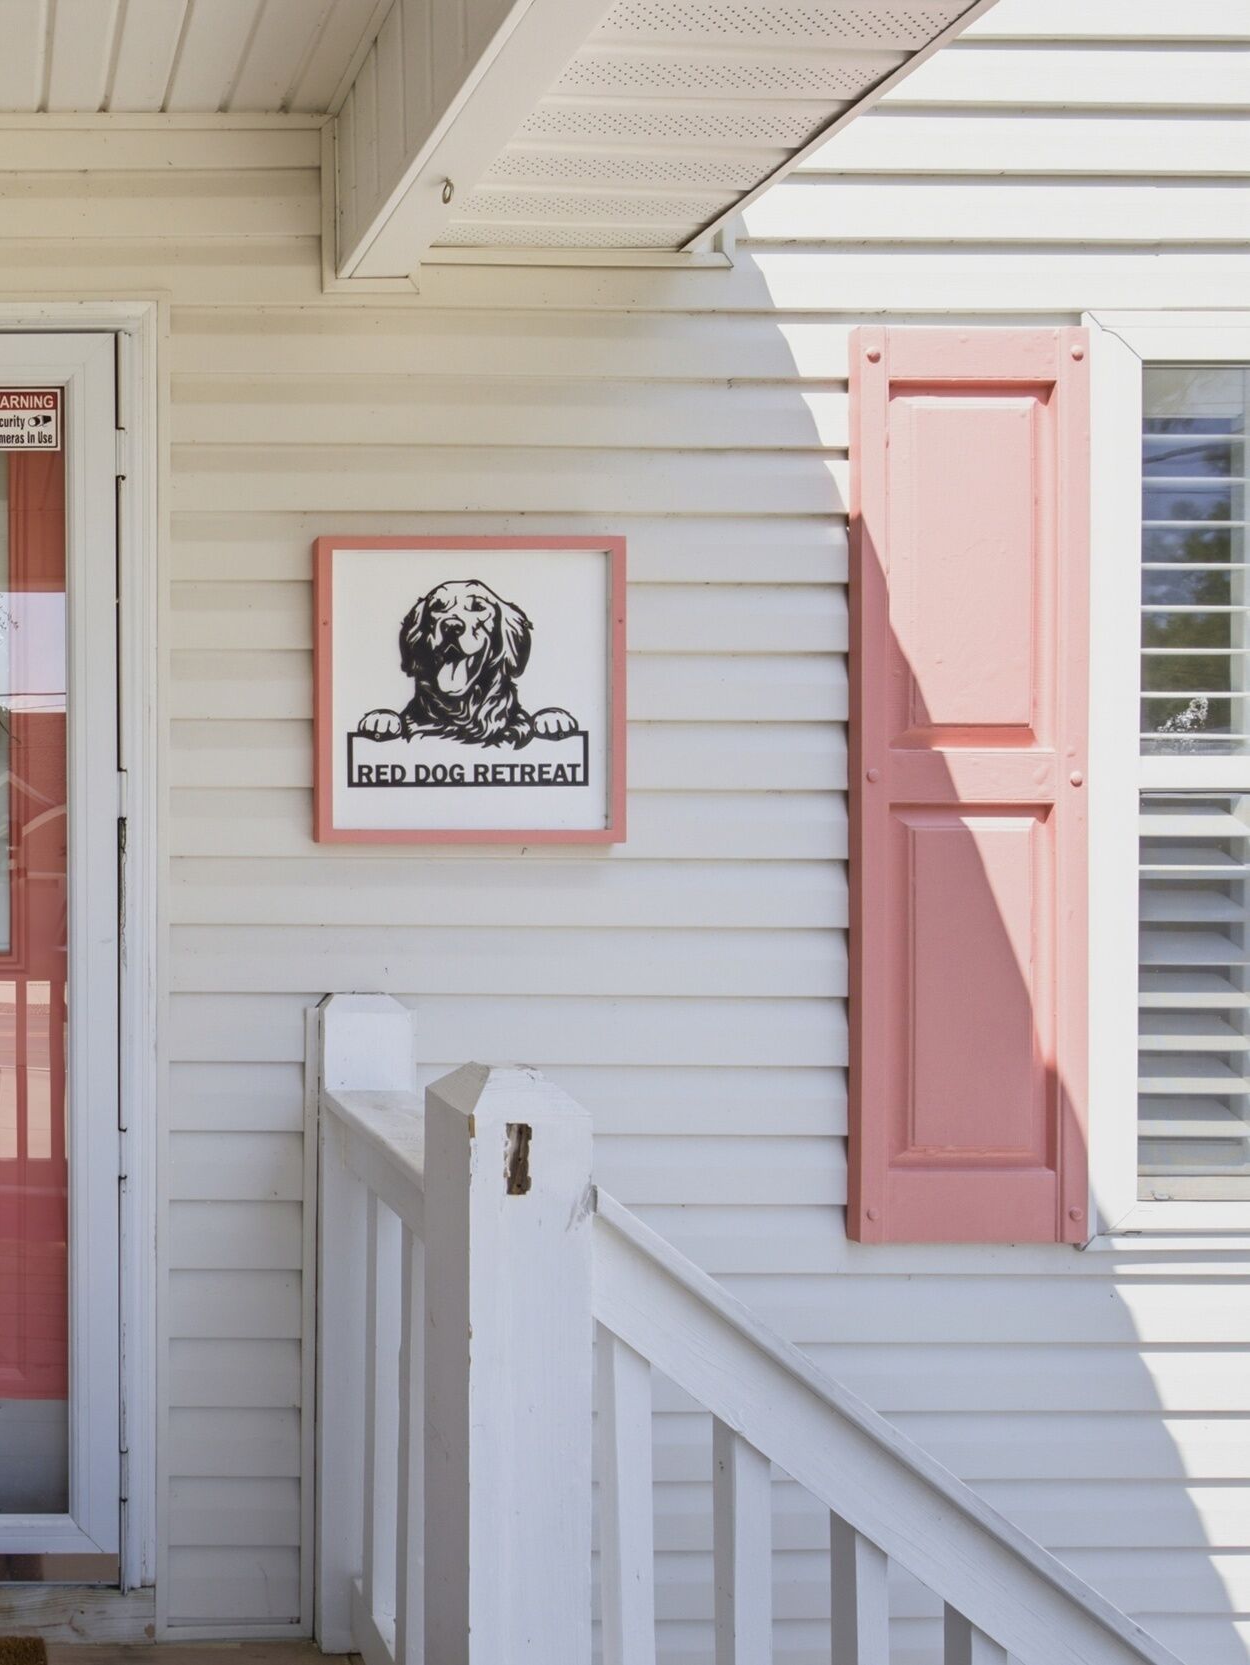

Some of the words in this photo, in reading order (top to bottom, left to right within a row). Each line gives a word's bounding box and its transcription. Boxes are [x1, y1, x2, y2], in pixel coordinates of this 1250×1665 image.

[27, 431, 36, 444] In
[38, 431, 53, 444] Use
[357, 764, 407, 784] RED
[414, 764, 465, 784] DOG
[473, 763, 581, 784] RETREAT
